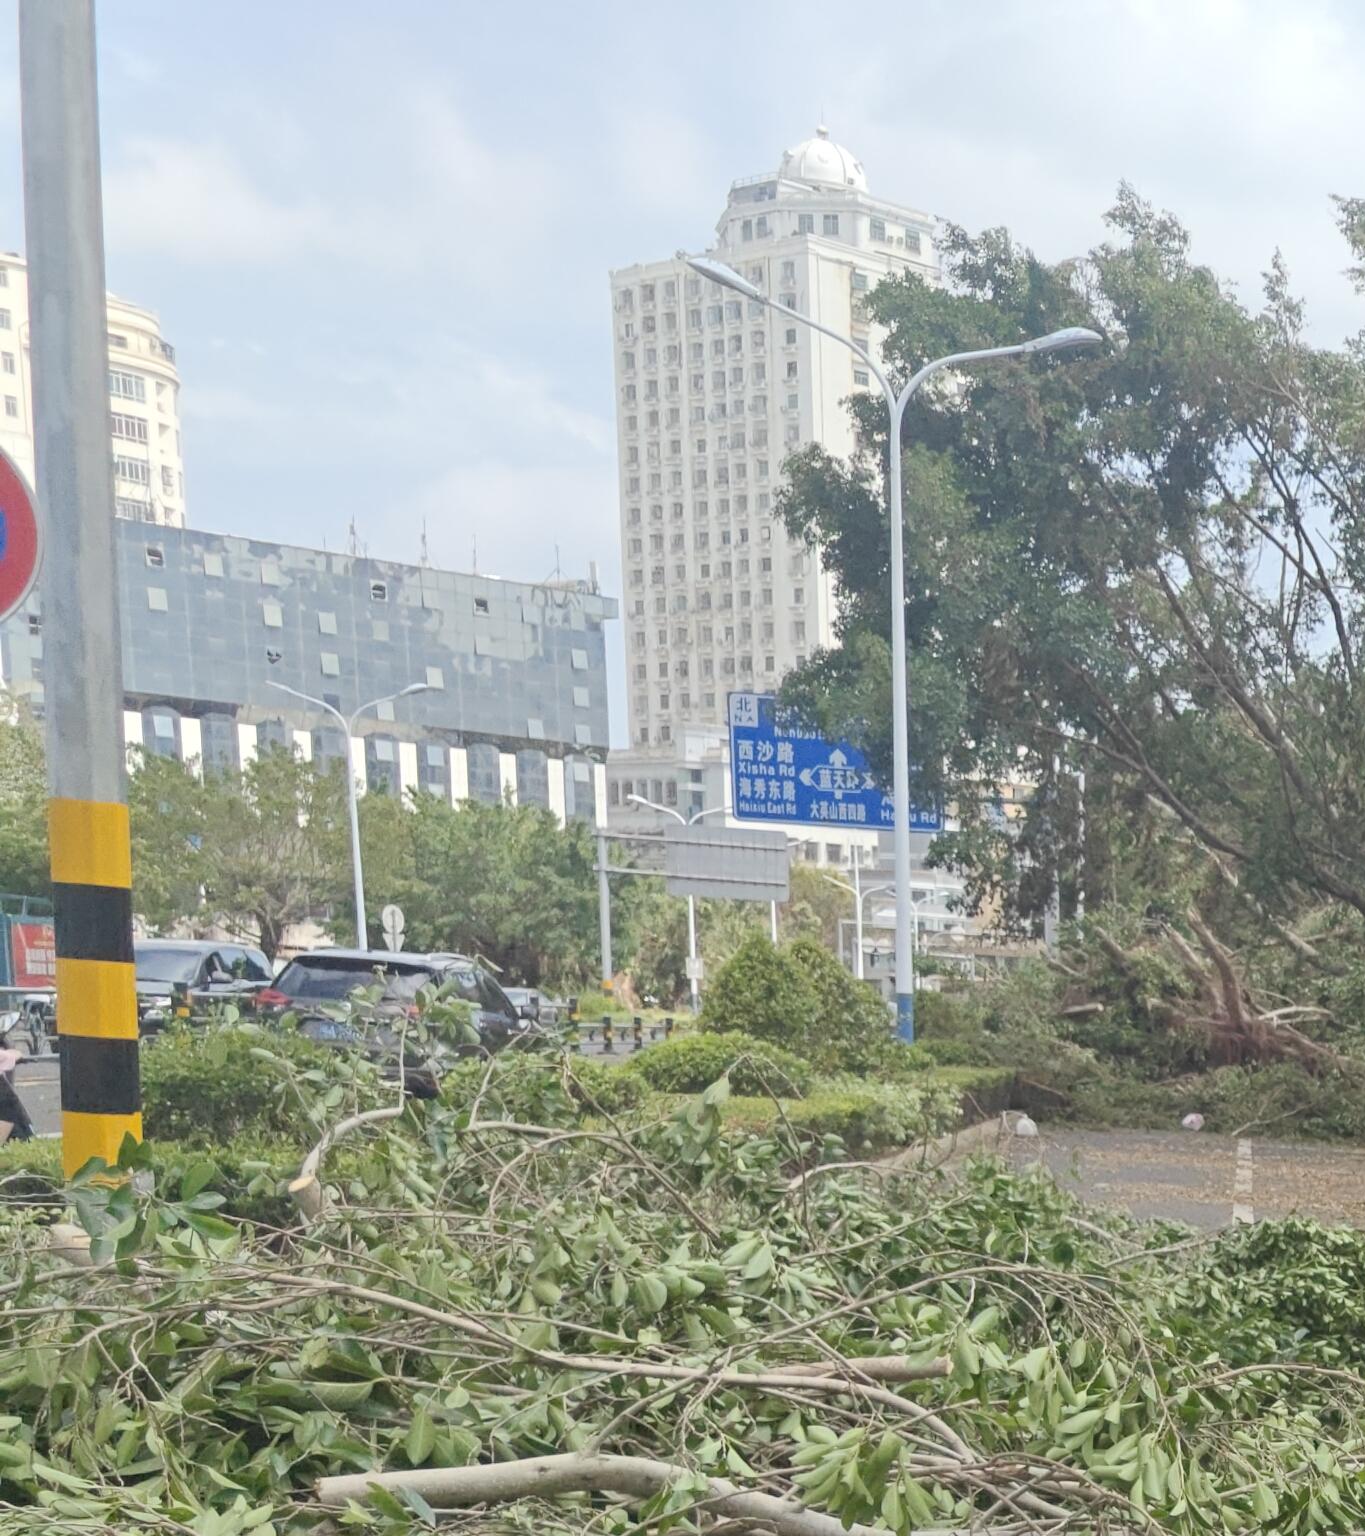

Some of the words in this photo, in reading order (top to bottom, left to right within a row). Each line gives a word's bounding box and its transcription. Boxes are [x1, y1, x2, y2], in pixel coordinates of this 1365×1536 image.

[736, 696, 752, 712] 北
[737, 739, 794, 764] 西沙路
[738, 761, 776, 776] Xisha
[779, 763, 796, 777] Rd
[739, 776, 796, 802] 海秀东路
[767, 801, 785, 815] East
[786, 802, 797, 816] Rd
[920, 811, 938, 824] Rd
